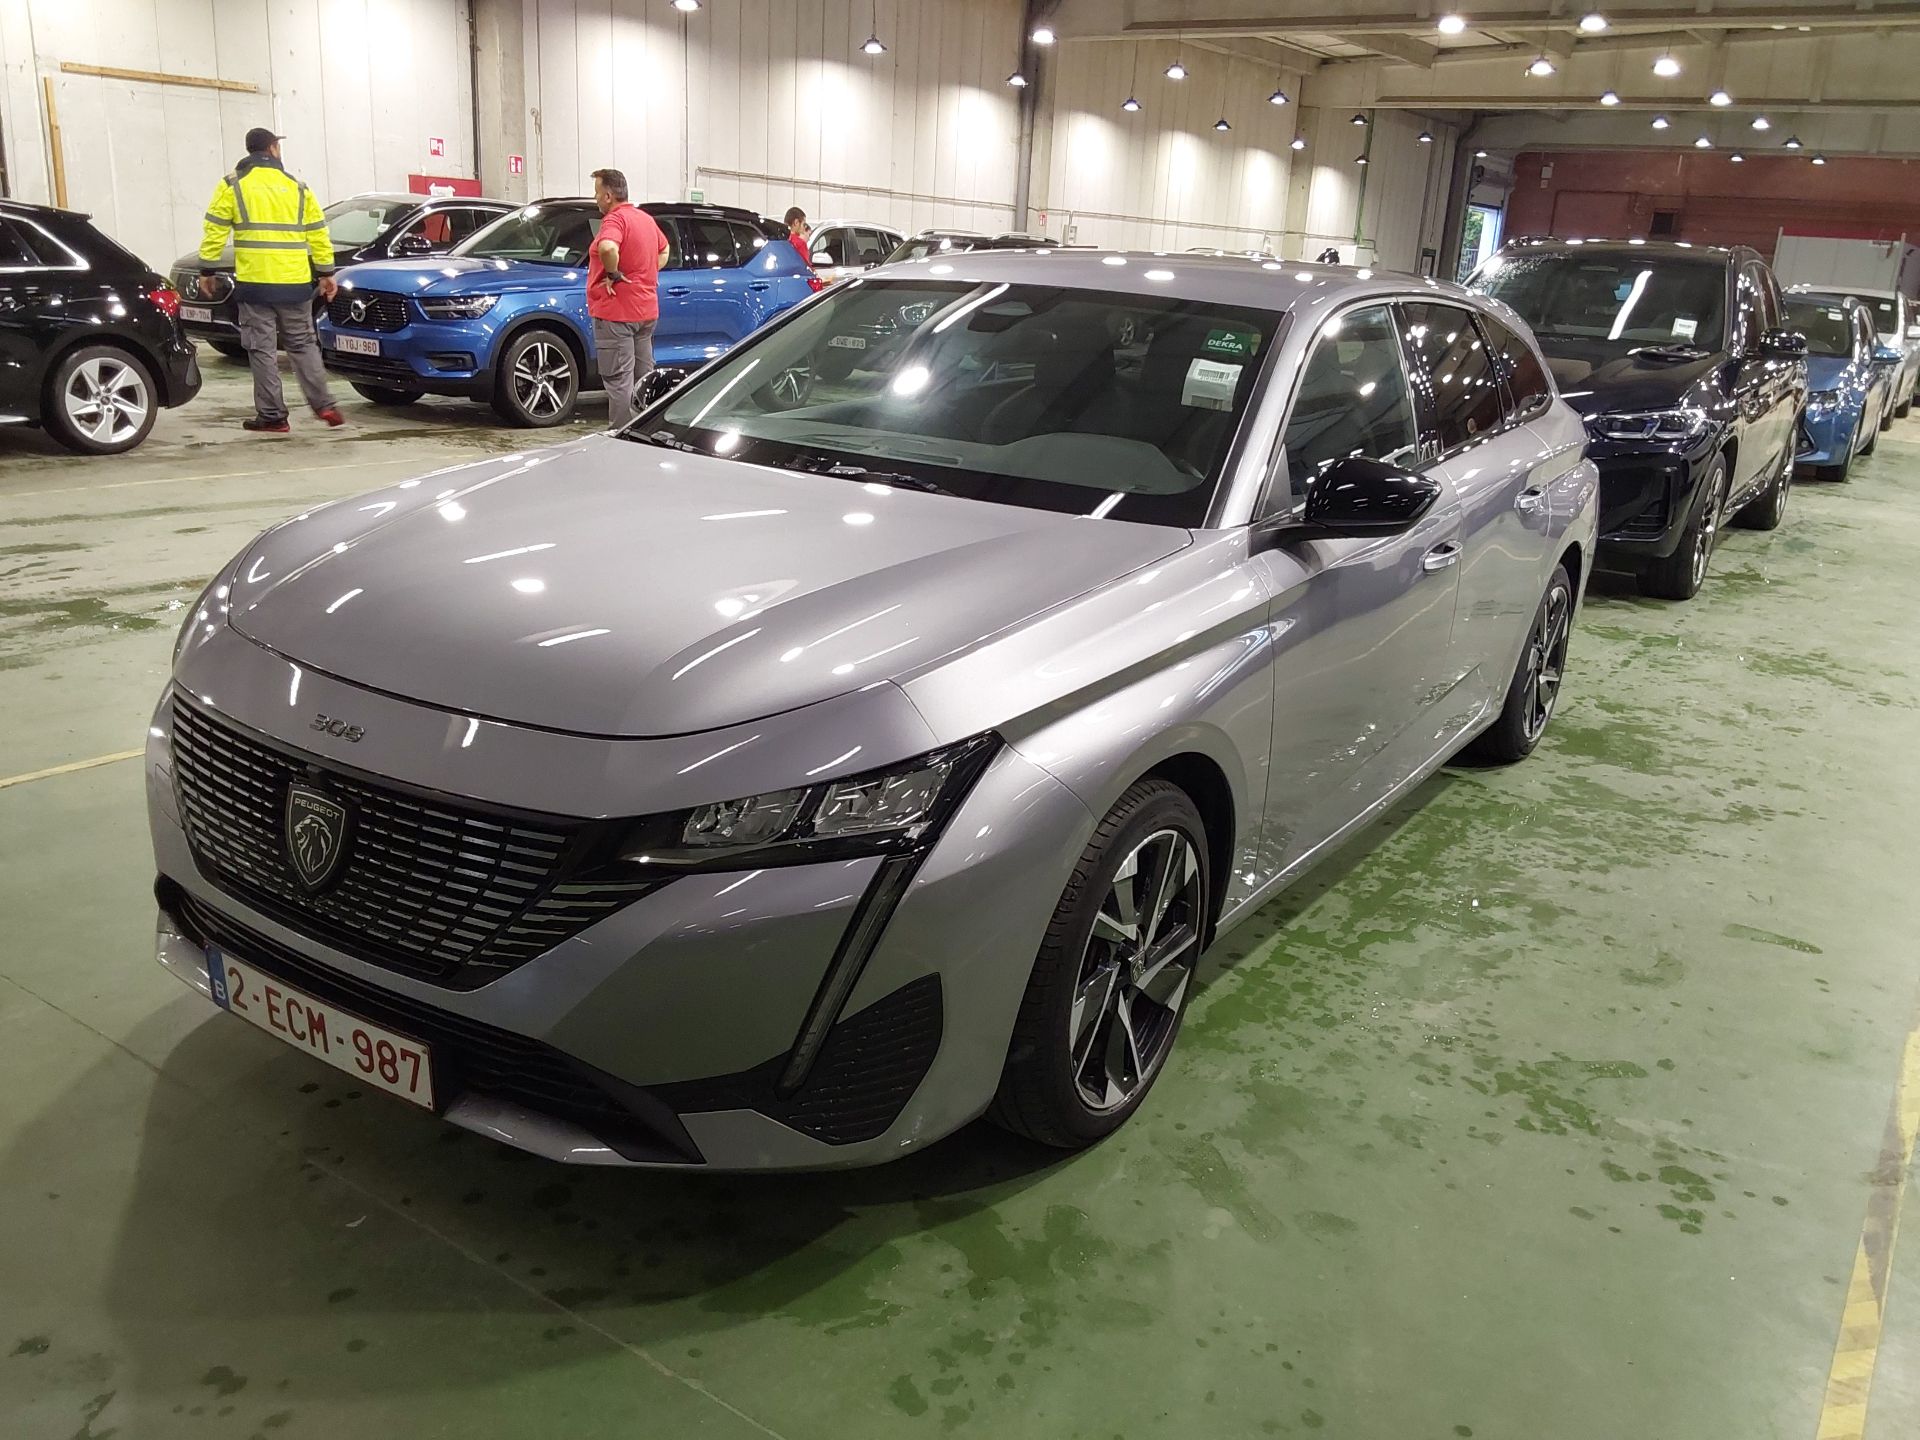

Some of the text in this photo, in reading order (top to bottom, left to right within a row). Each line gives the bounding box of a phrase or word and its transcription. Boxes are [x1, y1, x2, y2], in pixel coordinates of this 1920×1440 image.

[1207, 339, 1243, 350] DEKRA
[309, 713, 365, 743] 308
[294, 797, 340, 820] PEUGEOT
[215, 978, 226, 1001] B
[228, 966, 421, 1093] 2-ECM-987
